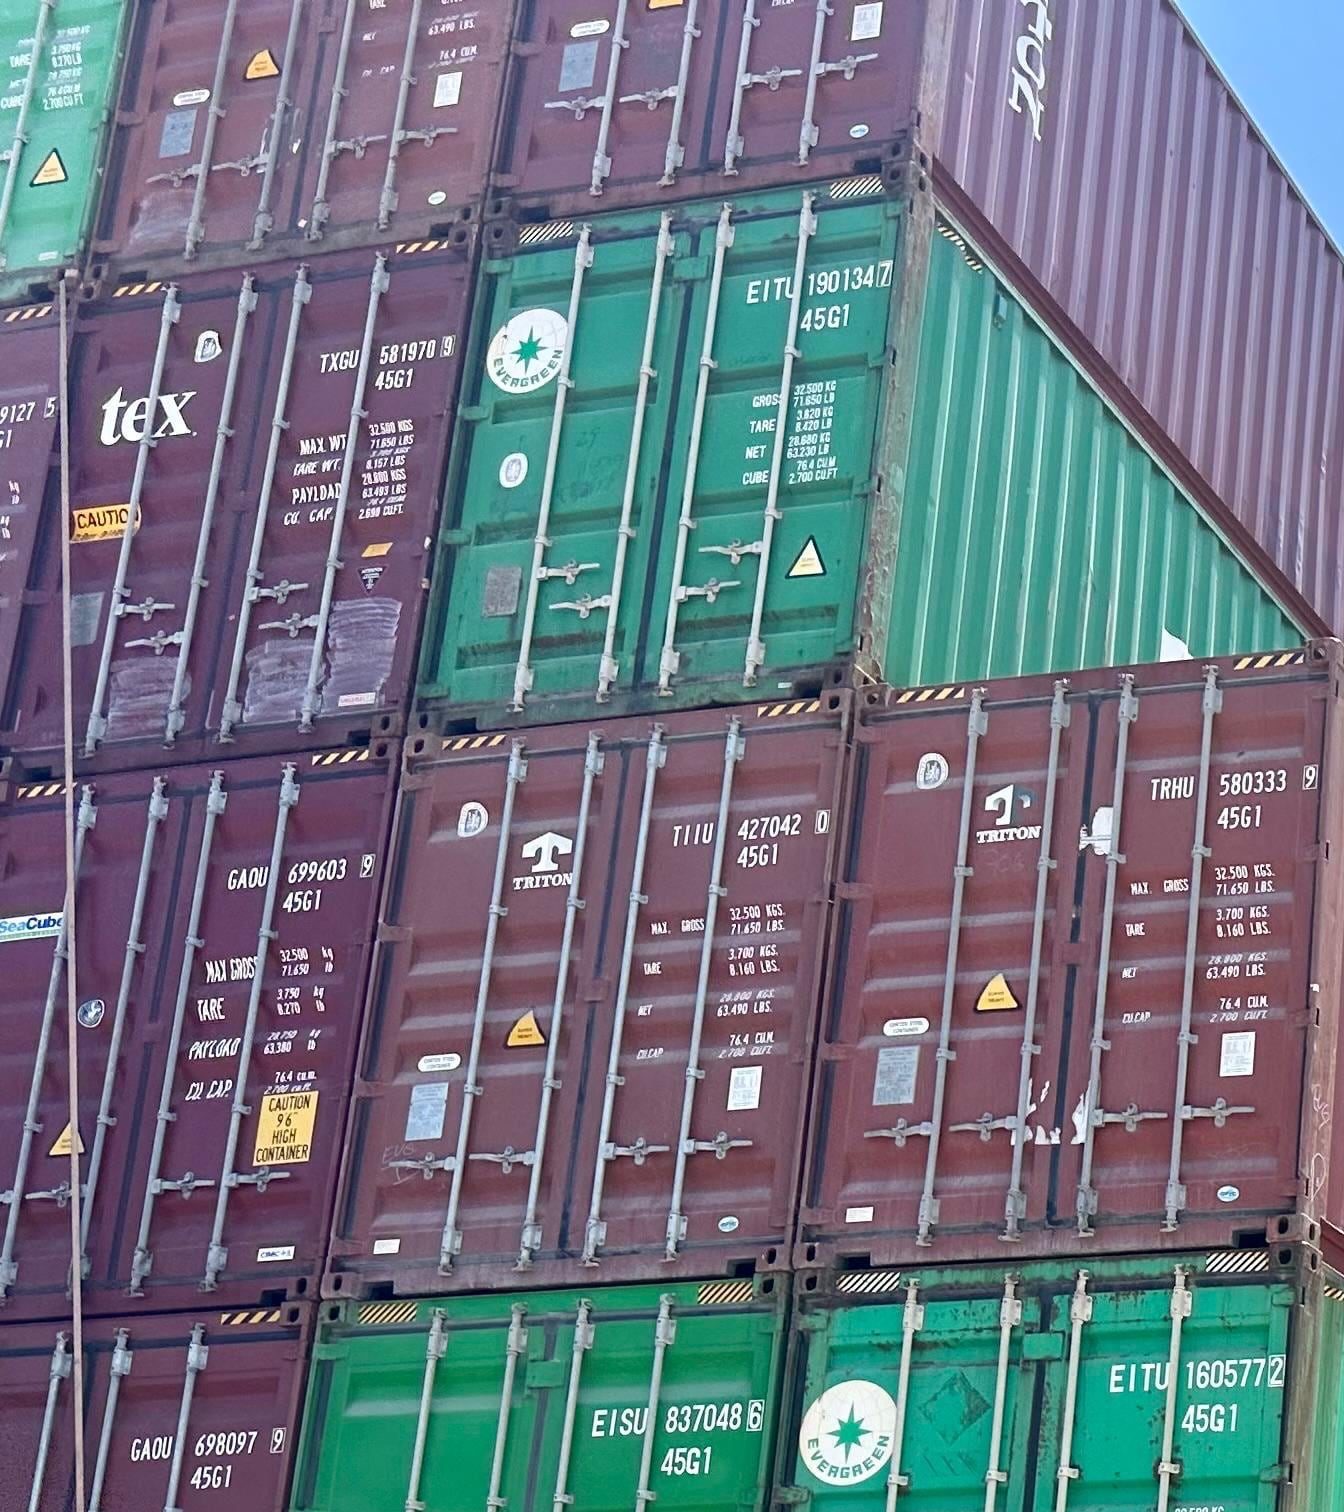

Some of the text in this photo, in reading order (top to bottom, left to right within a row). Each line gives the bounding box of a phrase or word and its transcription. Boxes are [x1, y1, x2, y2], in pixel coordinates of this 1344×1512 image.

[747, 278, 797, 304] EITU
[801, 303, 850, 332] 45G1
[320, 350, 358, 373] TXGU
[380, 340, 435, 366] 581970
[493, 348, 564, 389] EVERGREEN
[375, 368, 413, 392] 45G1
[100, 385, 197, 446] tex
[77, 507, 139, 531] CAUTIO
[1151, 767, 1317, 801] TRHU 580333 9
[673, 822, 714, 847] TIIU
[737, 814, 802, 841] 427042
[1217, 804, 1263, 830] 45G1
[976, 824, 1042, 845] TRITON
[737, 843, 779, 868] 45G1
[227, 855, 375, 890] GAOU 699603 9
[512, 872, 573, 890] TRITON
[282, 890, 322, 912] 45G1
[268, 1097, 311, 1111] CAUTION
[272, 1130, 297, 1144] HIGH
[256, 1145, 309, 1163] CONTAINER
[1109, 1363, 1170, 1394] EITU
[591, 1408, 649, 1438] EISU
[665, 1404, 742, 1434] 837048
[1181, 1404, 1238, 1434] 45G1
[130, 1428, 285, 1462] GAOU 698097 9
[806, 1434, 890, 1480] EVERGREEN
[660, 1447, 713, 1476] 45G1
[190, 1466, 233, 1490] 45G1
